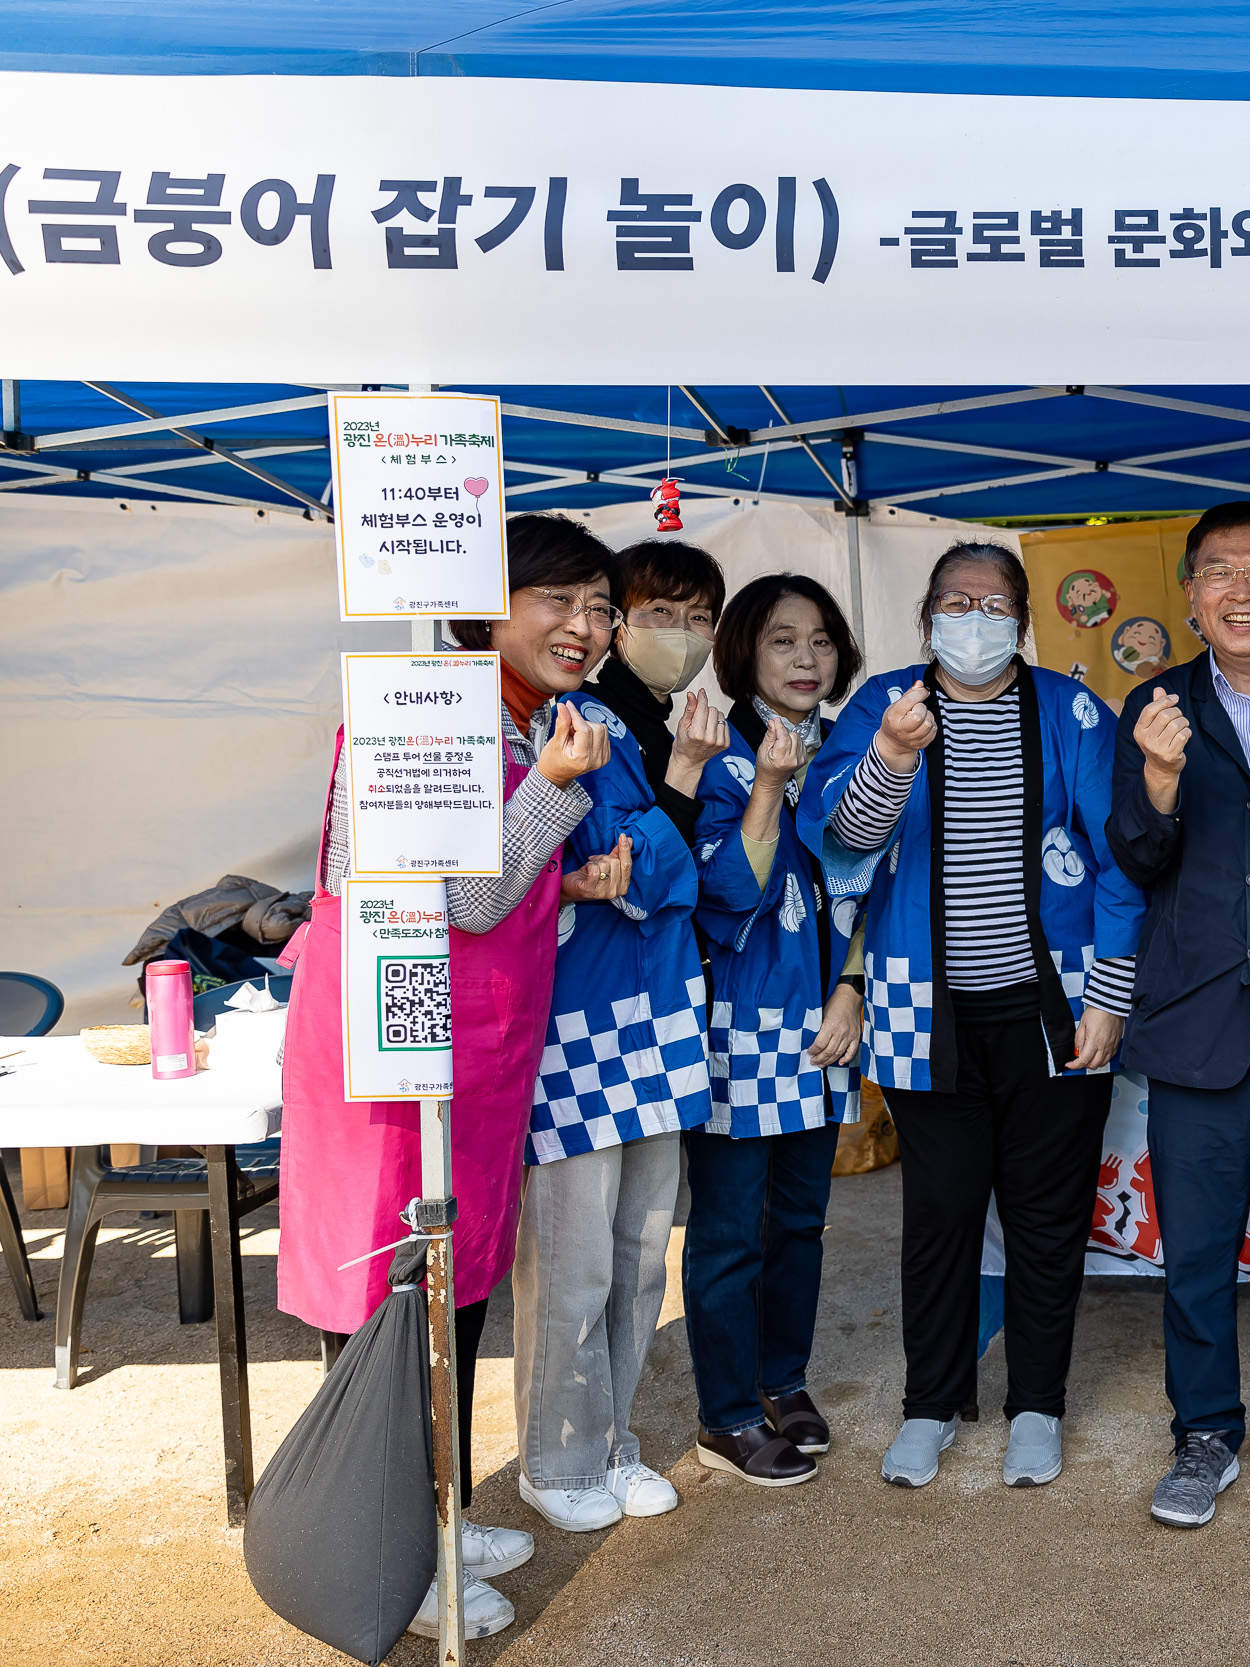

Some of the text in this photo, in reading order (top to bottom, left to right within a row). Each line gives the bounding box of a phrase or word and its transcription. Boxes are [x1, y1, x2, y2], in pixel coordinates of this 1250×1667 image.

[370, 176, 568, 272] 잡기
[606, 176, 840, 285] 놀이)
[879, 207, 1085, 269] -글로벌
[343, 421, 380, 432] 2023년
[343, 433, 371, 448] 광진
[439, 433, 495, 448] 가족축제
[381, 486, 460, 502] 11:40부터
[360, 510, 482, 529] 체험부스 운영이
[379, 539, 467, 555] 시작됩니다.
[409, 600, 459, 609] 광진구가족센터
[352, 736, 386, 746] 2023년
[455, 735, 496, 746] 가족축제
[373, 751, 474, 762] 스탬프 투어 선물 증정은
[376, 768, 471, 779] 공직선거법에 의거하여
[368, 783, 485, 794] 취소되었음을 알려드립니다.
[359, 799, 495, 810] 참여자분들의 양해부탁드립니다.
[410, 859, 459, 868] 광진구가족센터
[360, 899, 394, 910] 2023년
[359, 910, 385, 924] 광진
